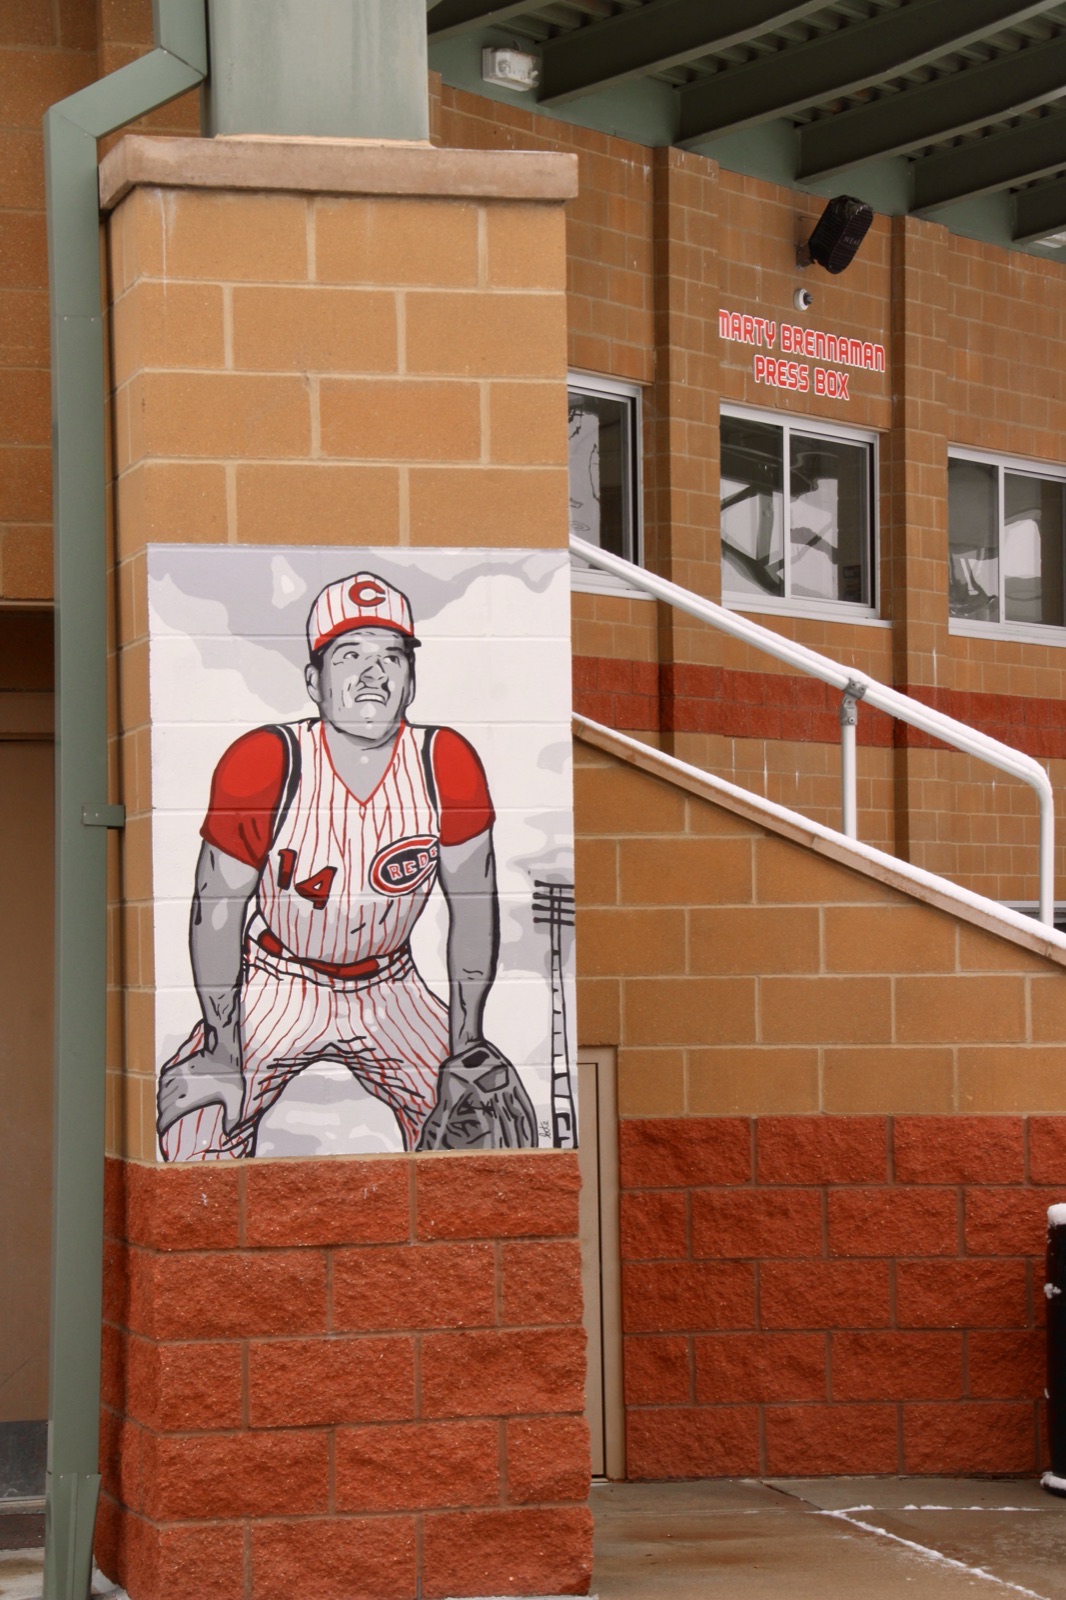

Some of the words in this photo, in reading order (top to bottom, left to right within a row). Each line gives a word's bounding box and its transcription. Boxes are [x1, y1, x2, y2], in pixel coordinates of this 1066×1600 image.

[719, 309, 776, 349] MARTY
[780, 323, 886, 372] BRENNAMAN
[754, 354, 809, 392] PRESS
[814, 367, 850, 400] BOX
[348, 580, 387, 607] C
[277, 848, 338, 910] 14
[387, 847, 438, 881] REDS
